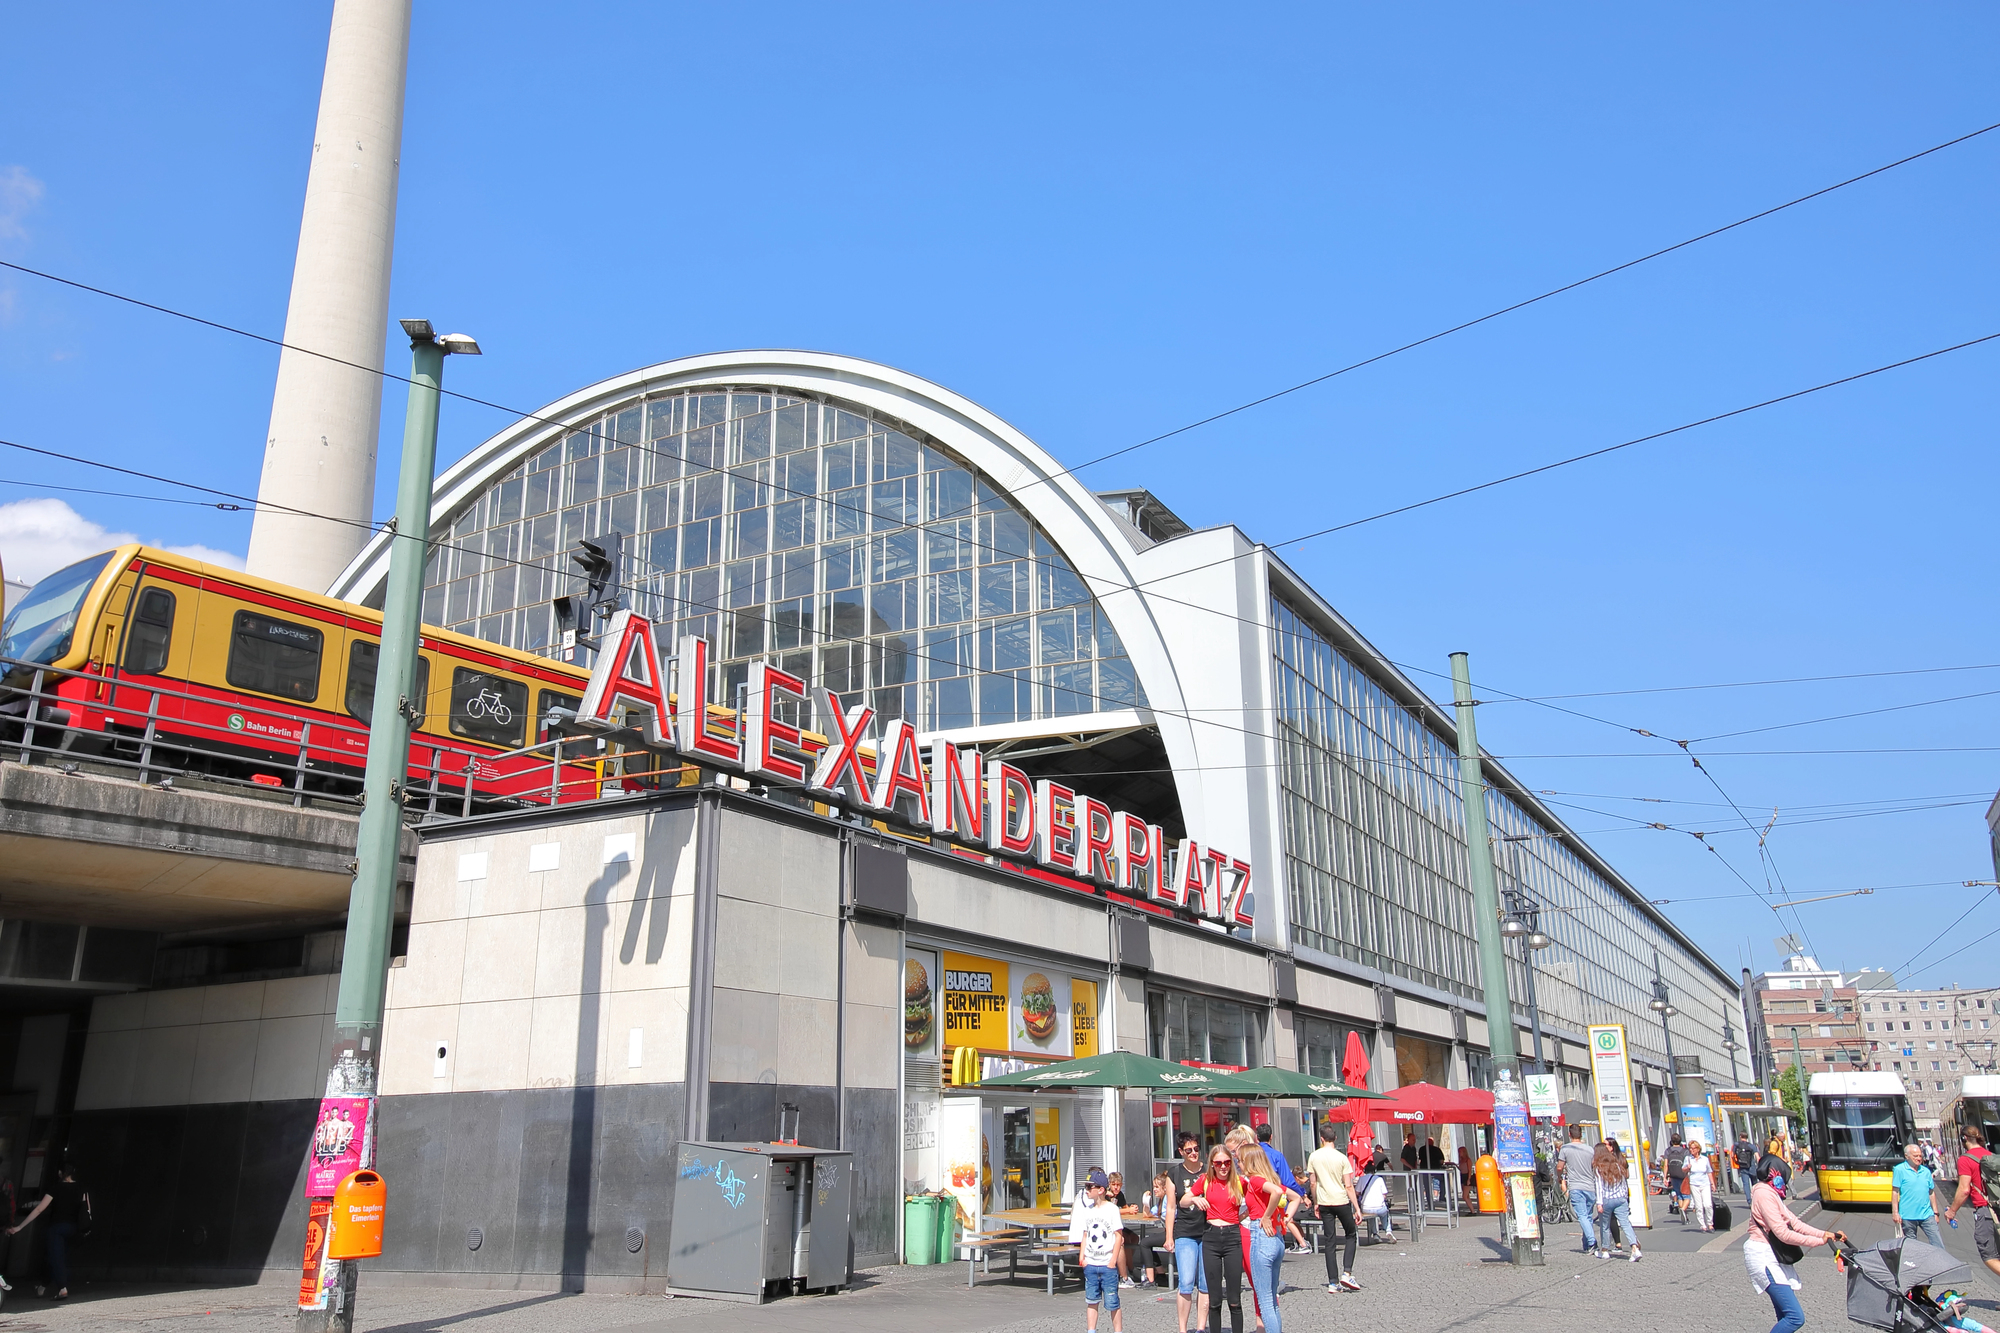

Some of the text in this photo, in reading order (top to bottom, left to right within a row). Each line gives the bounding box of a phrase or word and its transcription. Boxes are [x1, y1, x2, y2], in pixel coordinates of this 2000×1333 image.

[566, 634, 573, 644] 59
[246, 721, 267, 732] Bahn
[268, 725, 292, 737] Berlin
[576, 609, 1254, 928] ALEXANDERPLATZ
[945, 971, 992, 992] BURGER
[968, 994, 1005, 1011] MITTE?
[1073, 1002, 1086, 1015] ICH
[946, 1012, 981, 1030] BITTE!
[1074, 1017, 1095, 1030] LIEBE
[1075, 1032, 1087, 1045] ES!
[1394, 1111, 1415, 1121] Kamps
[1499, 1117, 1513, 1126] TANZ
[1037, 1144, 1057, 1162] 24/7
[1037, 1163, 1057, 1185] FÜR
[1038, 1184, 1050, 1195] DICH
[349, 1203, 383, 1214] Das tapfere
[351, 1214, 380, 1222] Eimerlein
